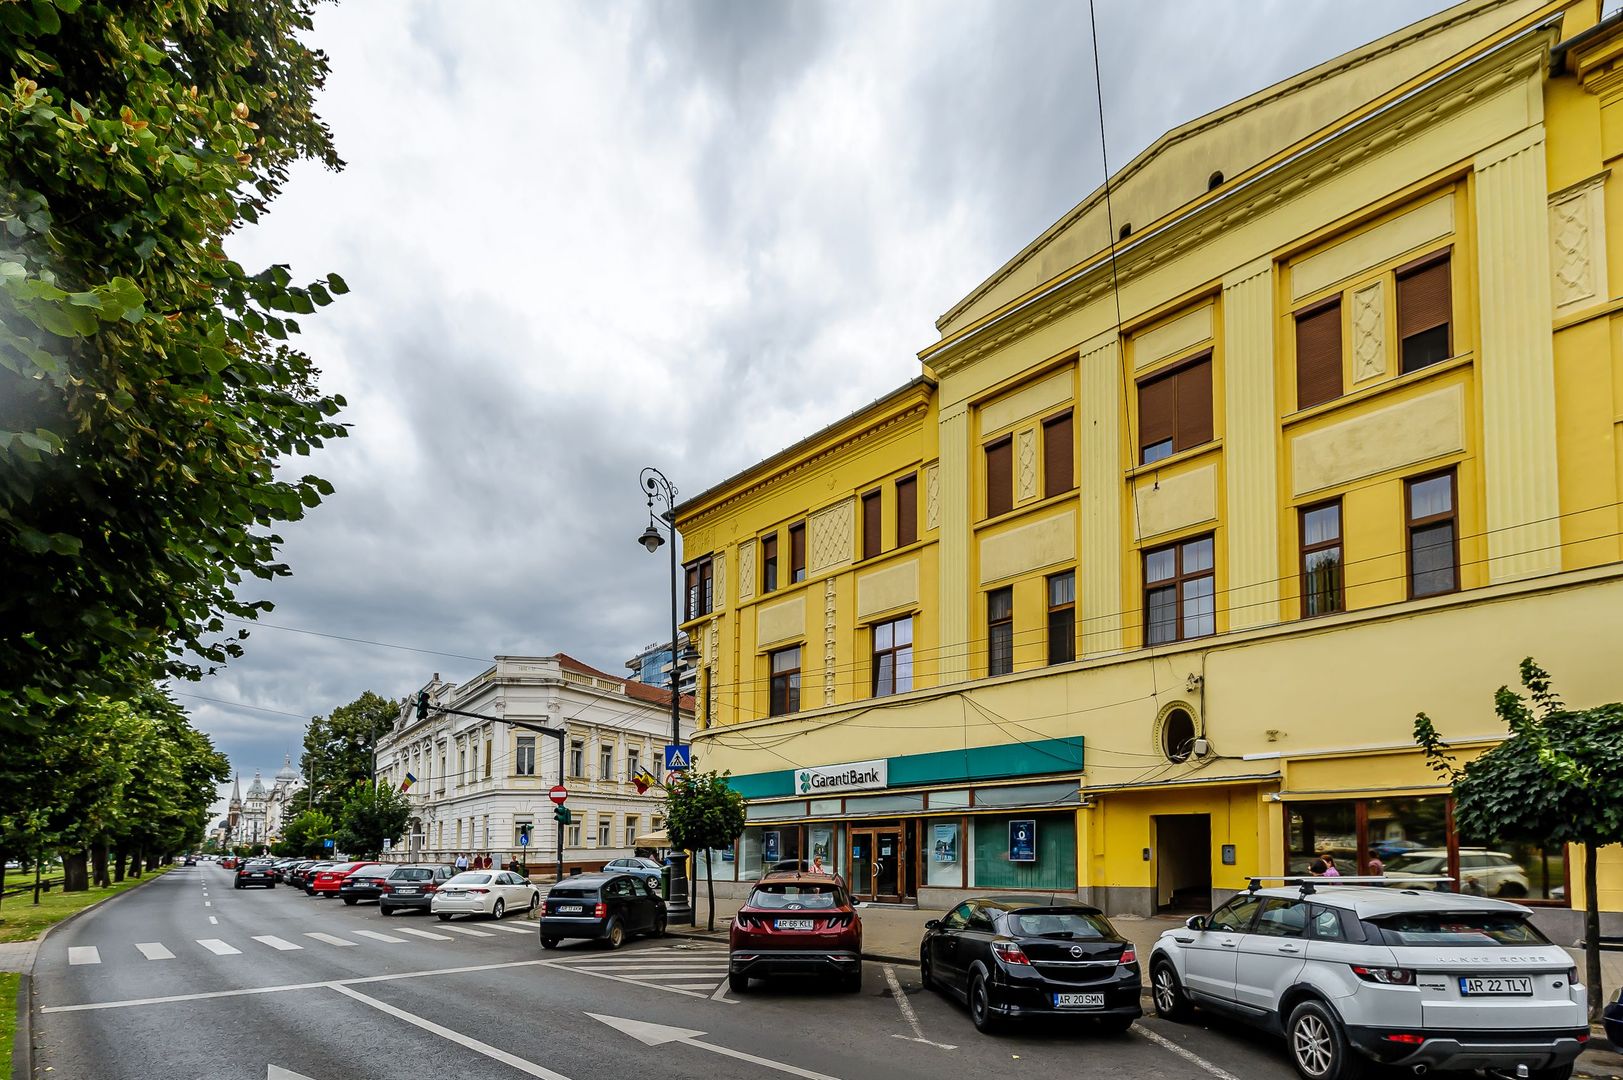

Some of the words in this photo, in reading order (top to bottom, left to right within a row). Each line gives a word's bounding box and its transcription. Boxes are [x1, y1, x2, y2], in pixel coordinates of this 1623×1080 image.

[811, 768, 879, 788] GarantiBank
[1468, 980, 1484, 992] AR
[1487, 980, 1503, 992] 22
[1505, 979, 1529, 992] TLY
[1060, 995, 1071, 1004] AR
[1073, 995, 1084, 1004] 20
[1085, 995, 1103, 1004] SMN
